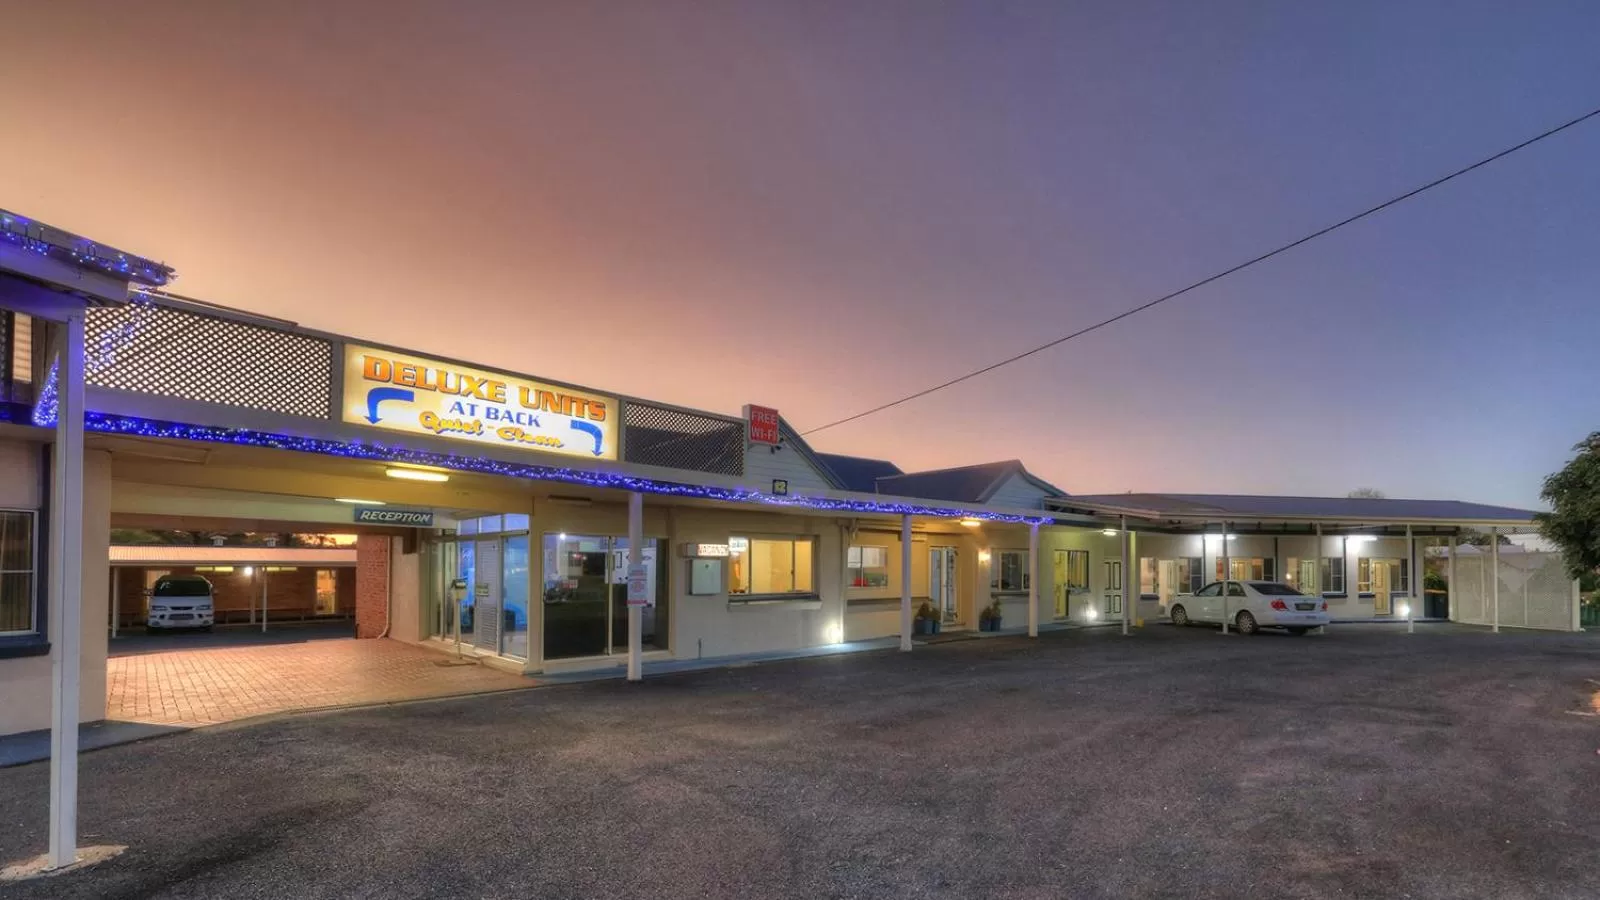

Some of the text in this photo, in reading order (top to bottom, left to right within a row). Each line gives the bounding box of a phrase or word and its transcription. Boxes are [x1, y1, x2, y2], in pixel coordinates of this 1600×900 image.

[363, 356, 606, 421] DELUXE UNITS
[449, 401, 541, 427] AT BACK
[752, 411, 776, 425] FREE
[419, 411, 484, 436] Quiet
[496, 427, 564, 448] Clean
[360, 510, 431, 523] RECEPTION
